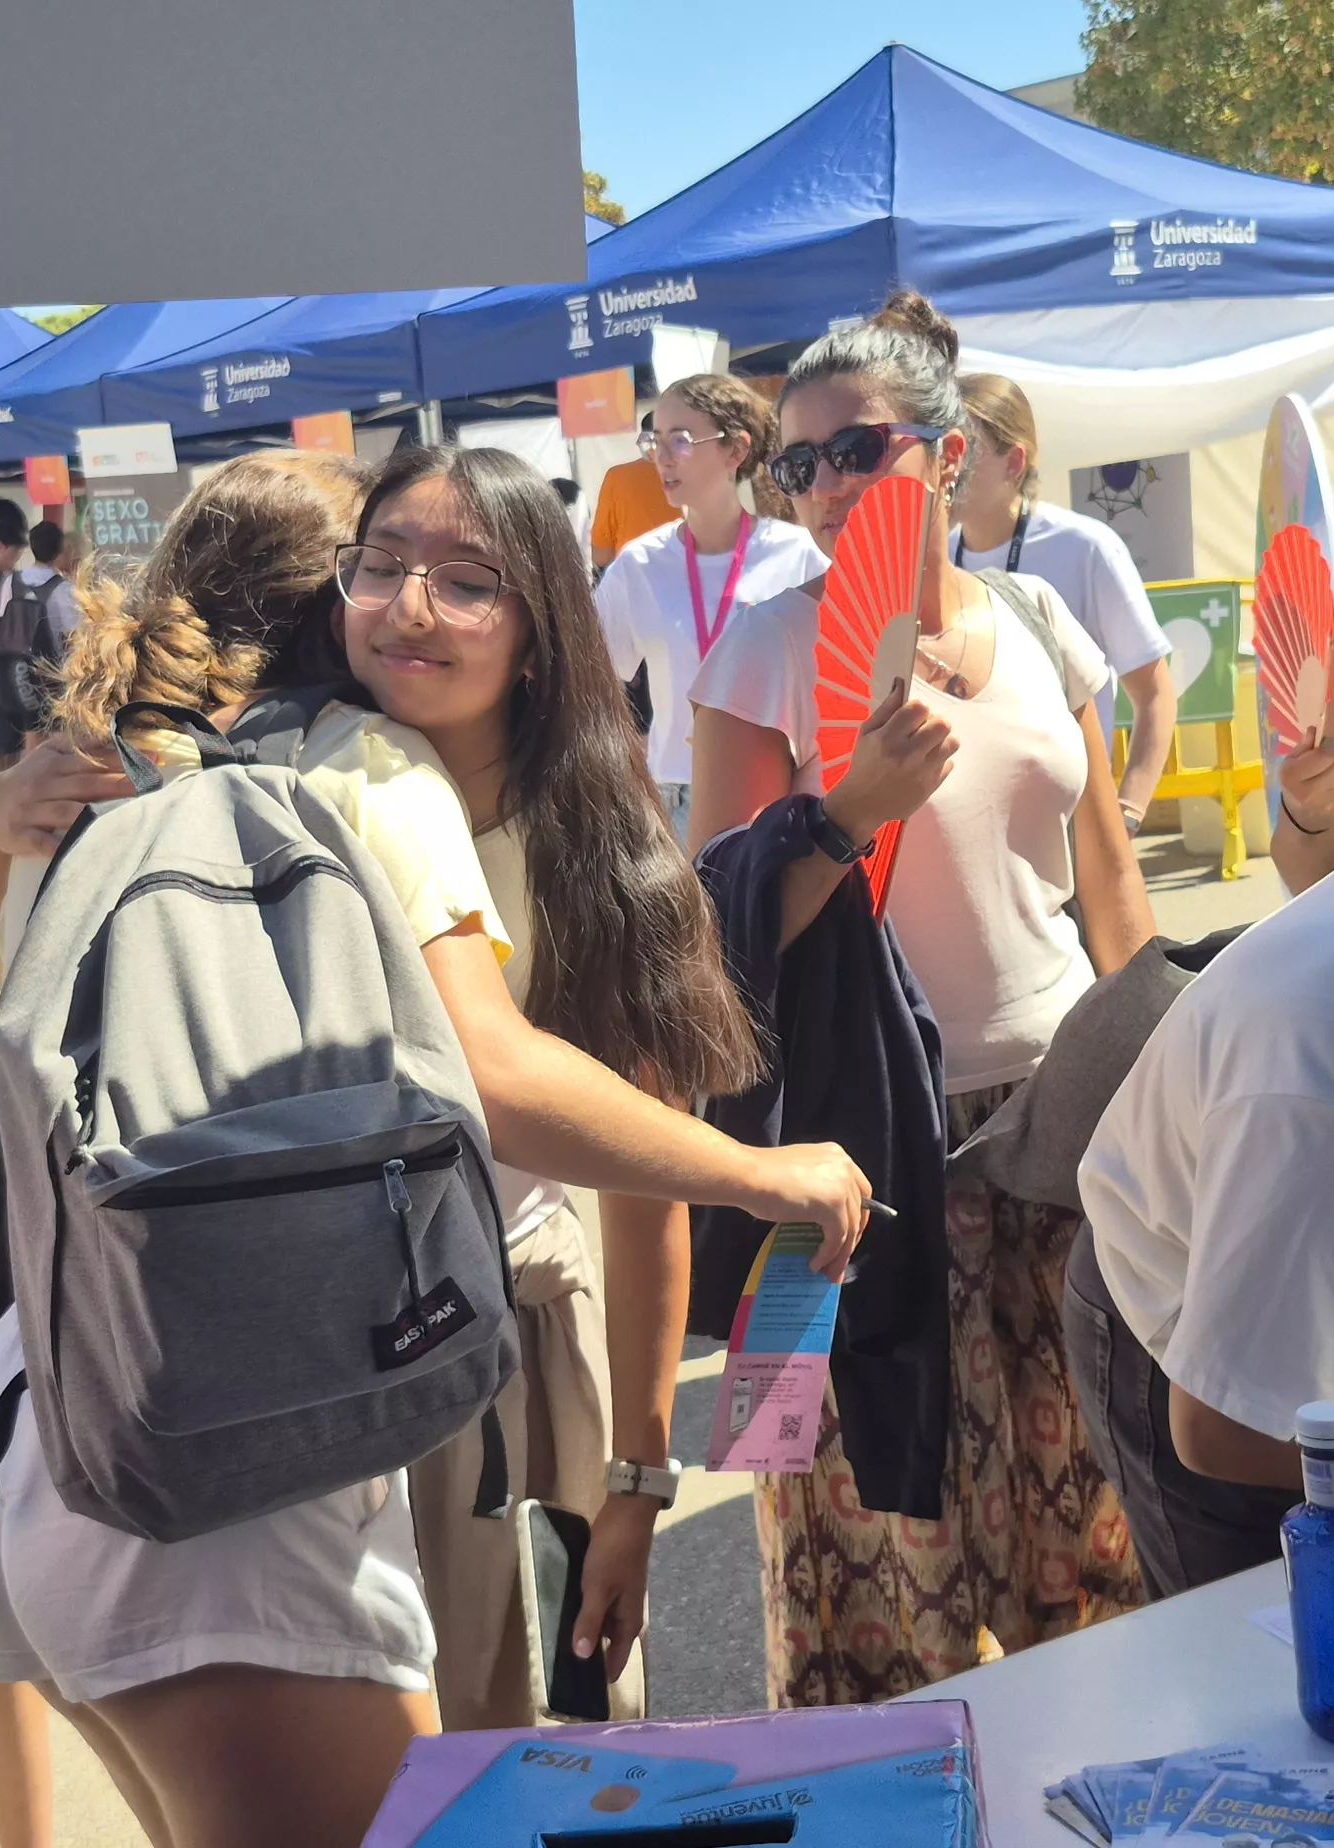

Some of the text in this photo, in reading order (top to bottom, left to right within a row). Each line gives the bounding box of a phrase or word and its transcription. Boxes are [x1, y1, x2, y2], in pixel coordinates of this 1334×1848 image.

[1150, 216, 1256, 246] Universidad
[1153, 250, 1223, 271] Zaragoza
[598, 273, 698, 316] Universidad
[602, 312, 664, 339] Zaragoza
[224, 355, 291, 386] Universidad
[226, 383, 270, 404] Zaragoza
[93, 497, 149, 522] SEXO
[95, 521, 163, 546] GRATI
[520, 1747, 593, 1773] VISA
